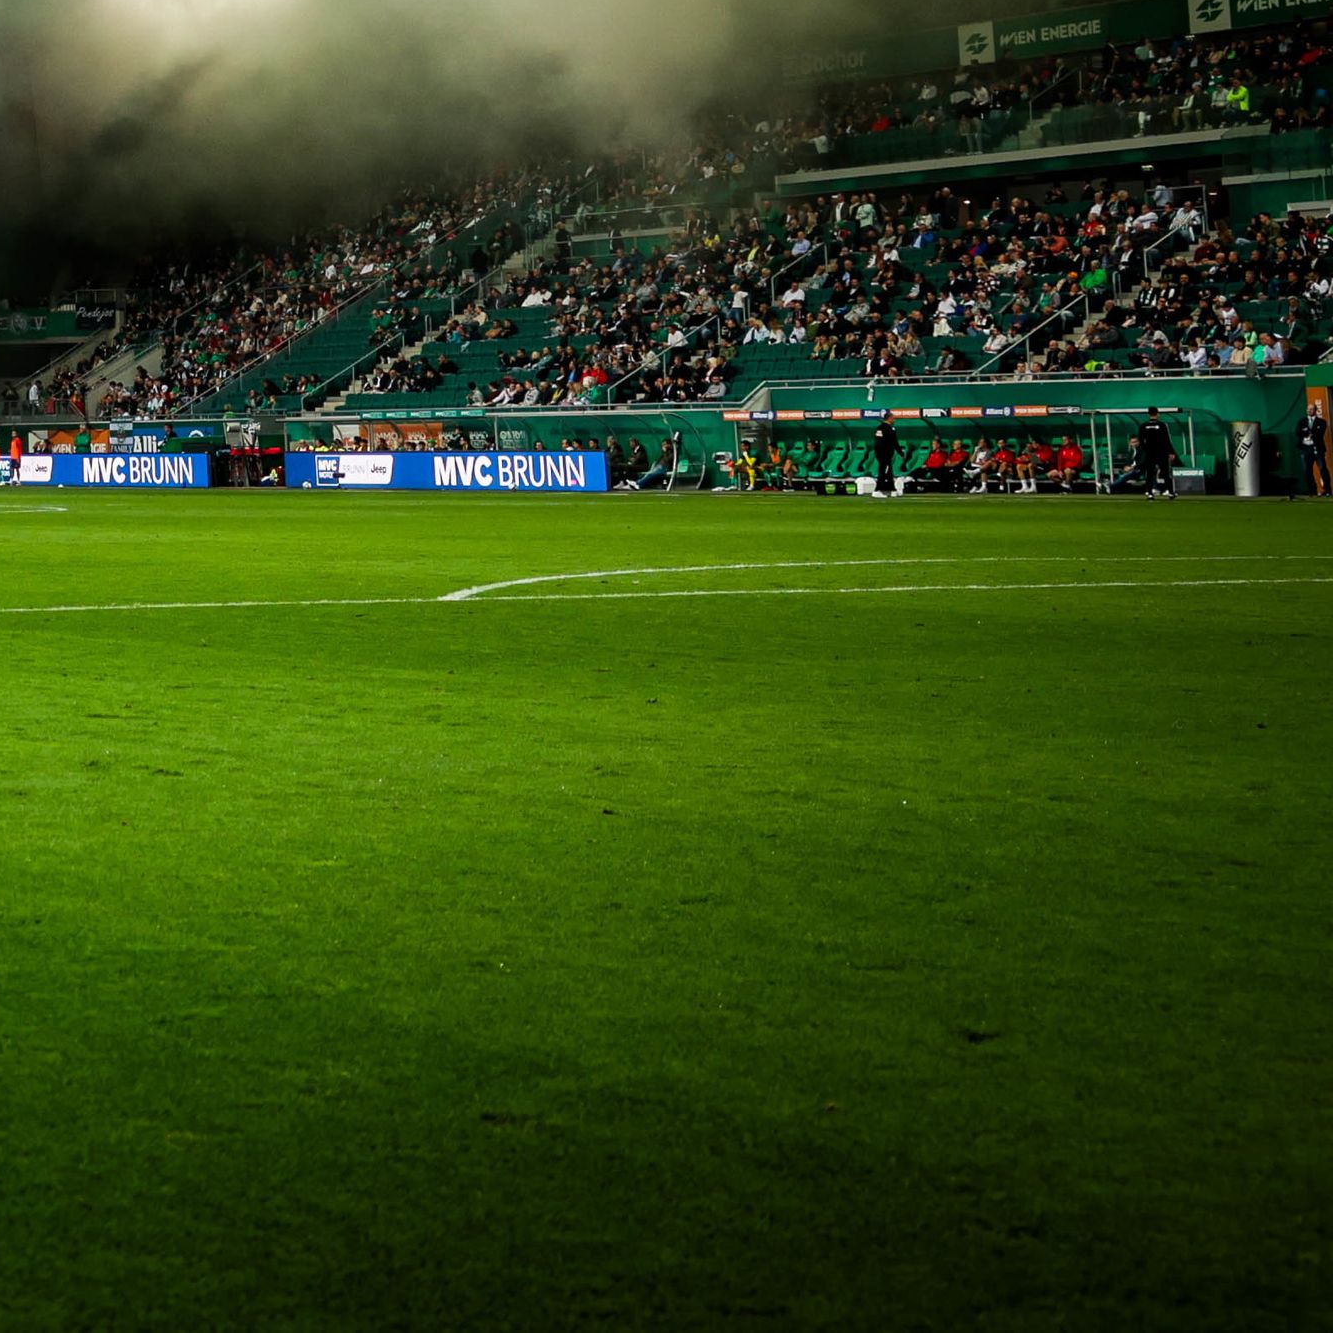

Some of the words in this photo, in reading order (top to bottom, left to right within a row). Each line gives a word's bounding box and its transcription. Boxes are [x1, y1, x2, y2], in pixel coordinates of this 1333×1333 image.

[999, 28, 1034, 47] WIEN
[1041, 20, 1100, 40] ENERGIE
[84, 457, 126, 484] MVC
[130, 456, 194, 484] BRUNN
[434, 456, 493, 486] MVC
[498, 456, 584, 488] BRUNN
